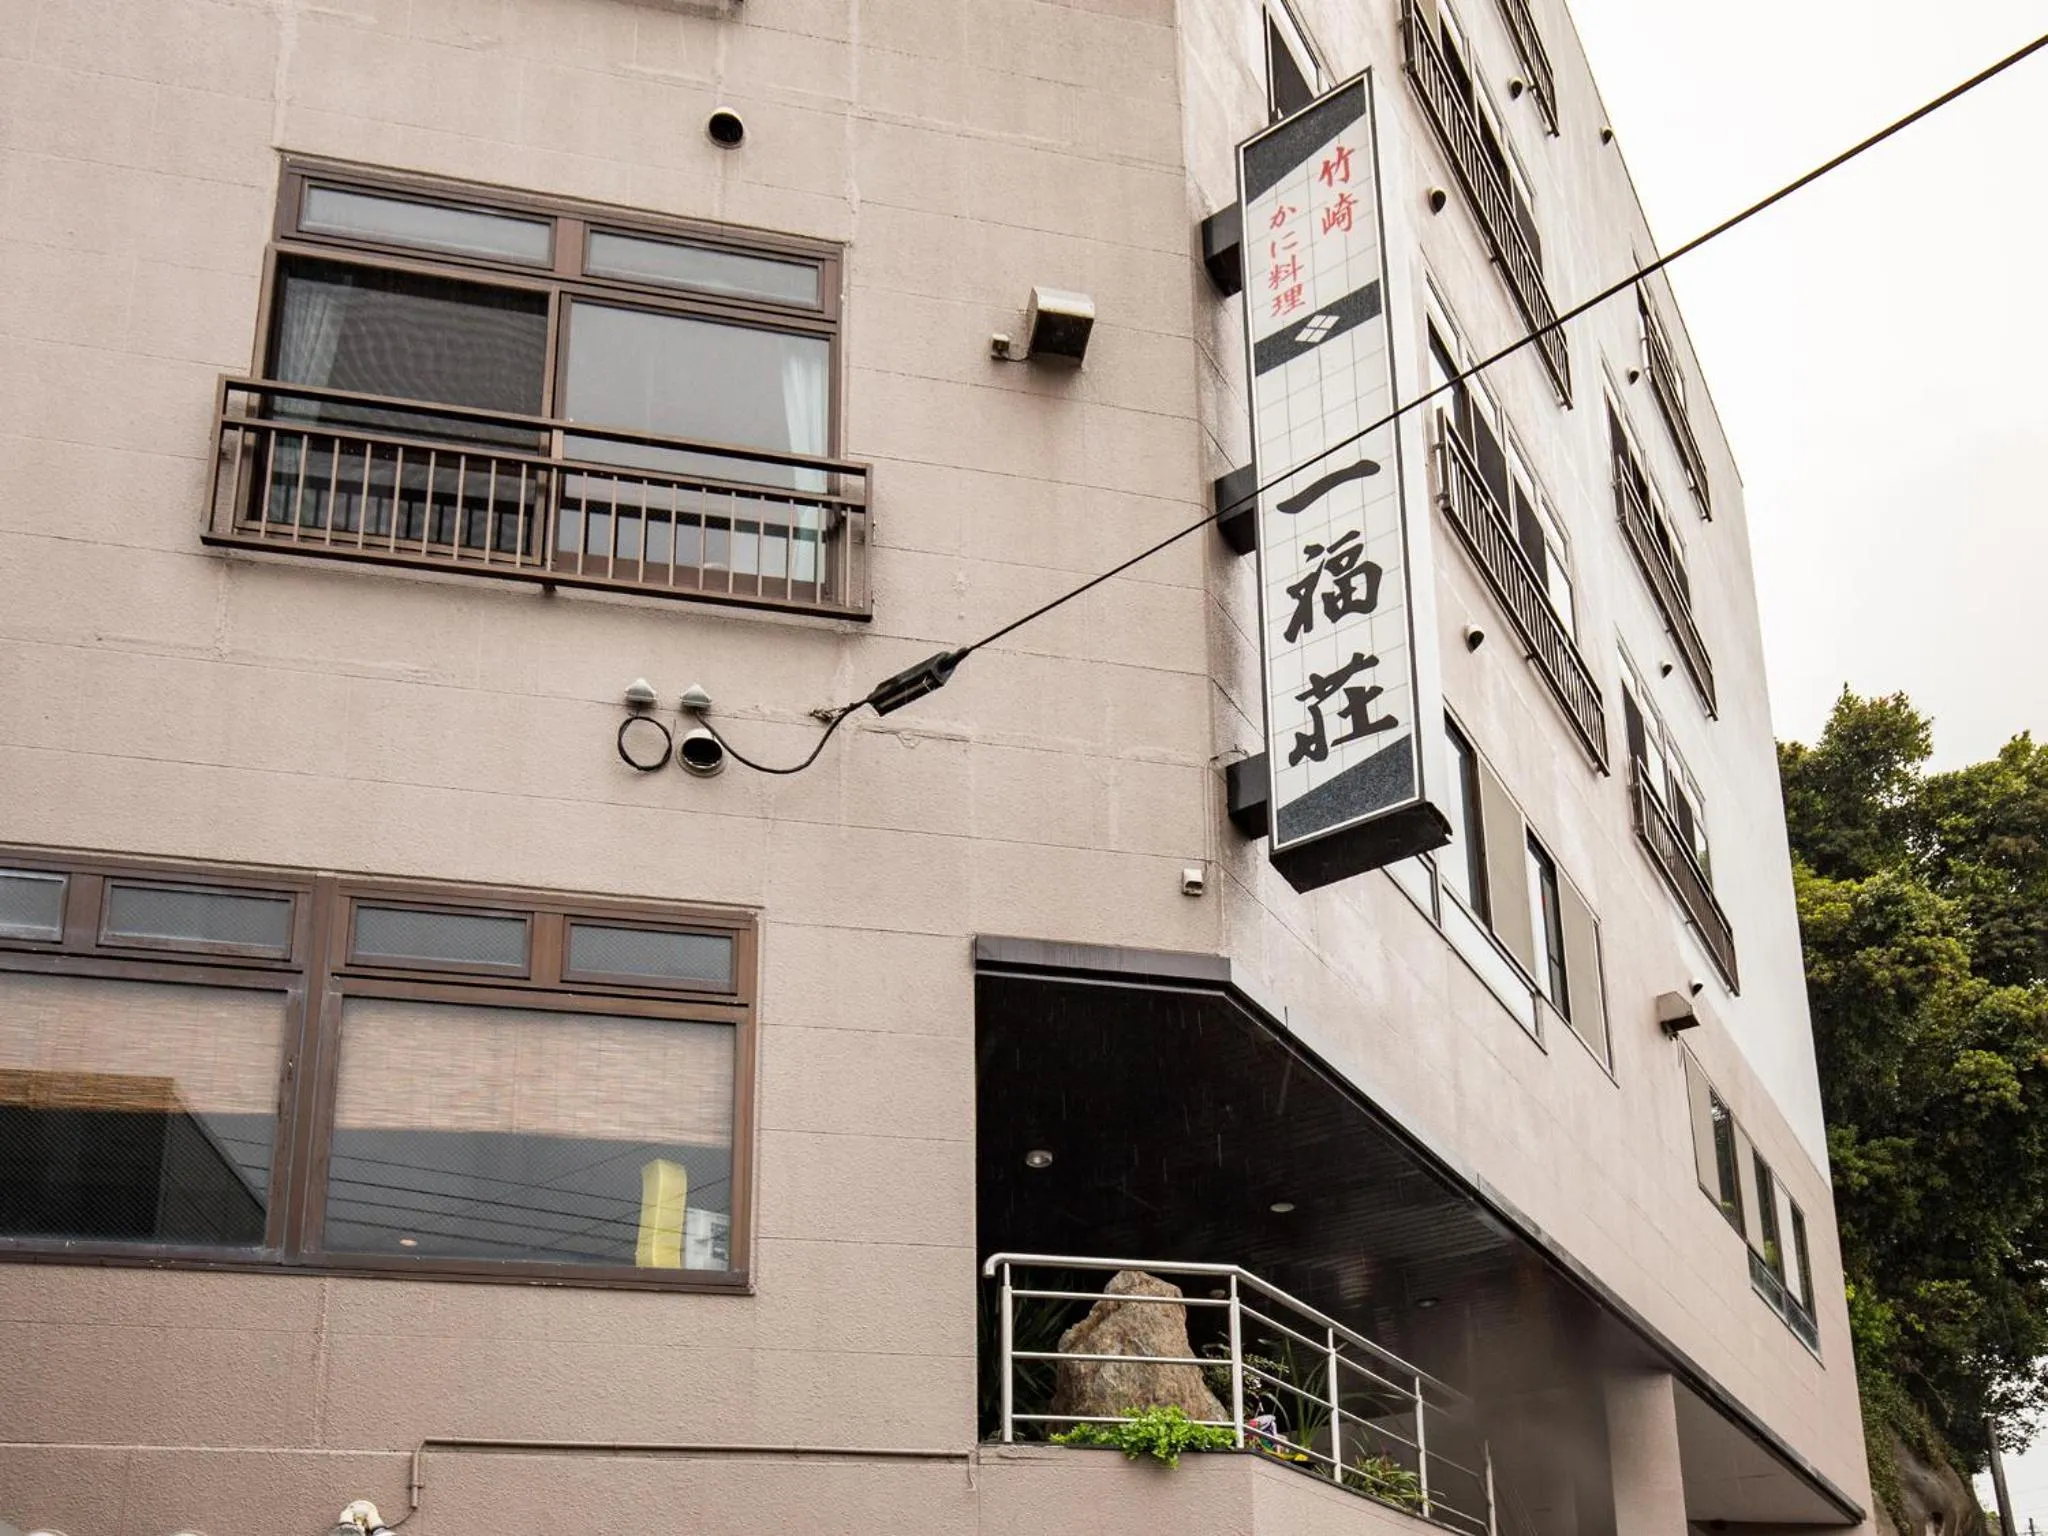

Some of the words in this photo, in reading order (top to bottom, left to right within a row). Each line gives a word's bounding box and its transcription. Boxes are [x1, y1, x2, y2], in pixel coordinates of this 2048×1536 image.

[1320, 146, 1358, 234] 竹崎
[1269, 205, 1305, 317] かに料理
[1277, 460, 1398, 767] 一福荘
